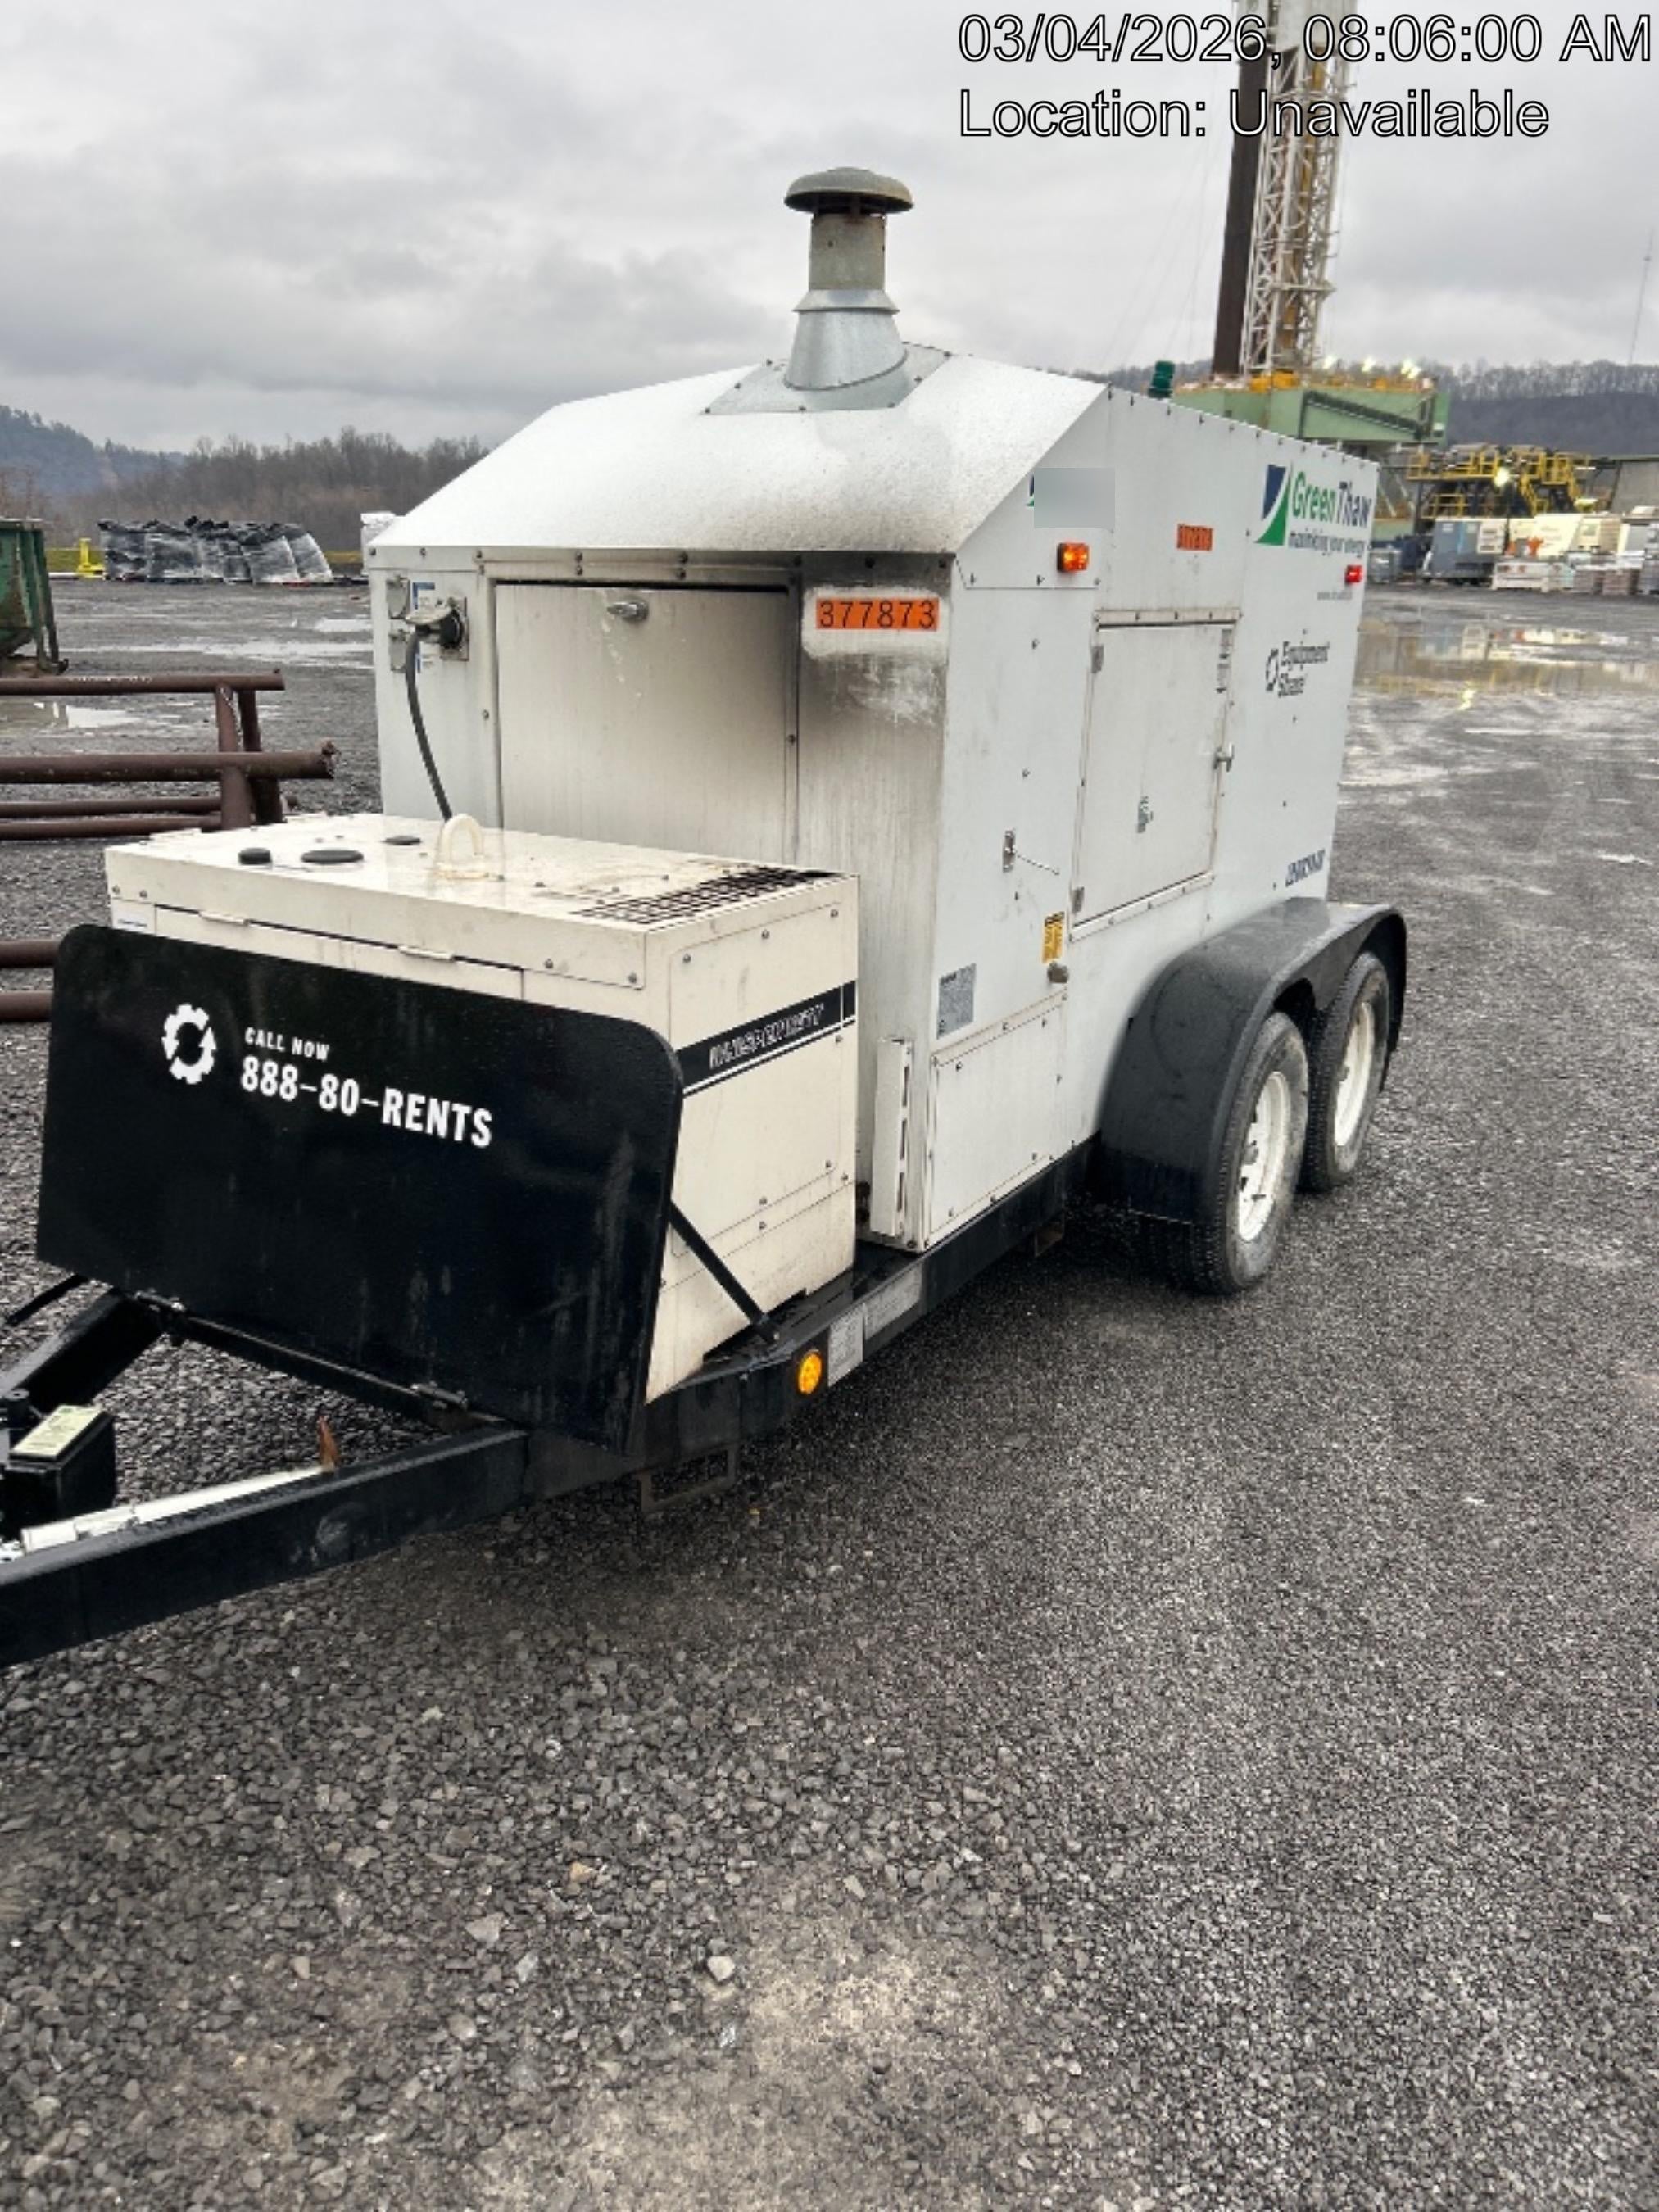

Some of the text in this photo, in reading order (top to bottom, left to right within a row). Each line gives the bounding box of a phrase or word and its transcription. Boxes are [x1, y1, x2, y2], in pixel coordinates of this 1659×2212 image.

[819, 599, 936, 629] 377873
[245, 1026, 330, 1062] CALL NOW
[241, 1054, 493, 1148] 888-80-RENTS
